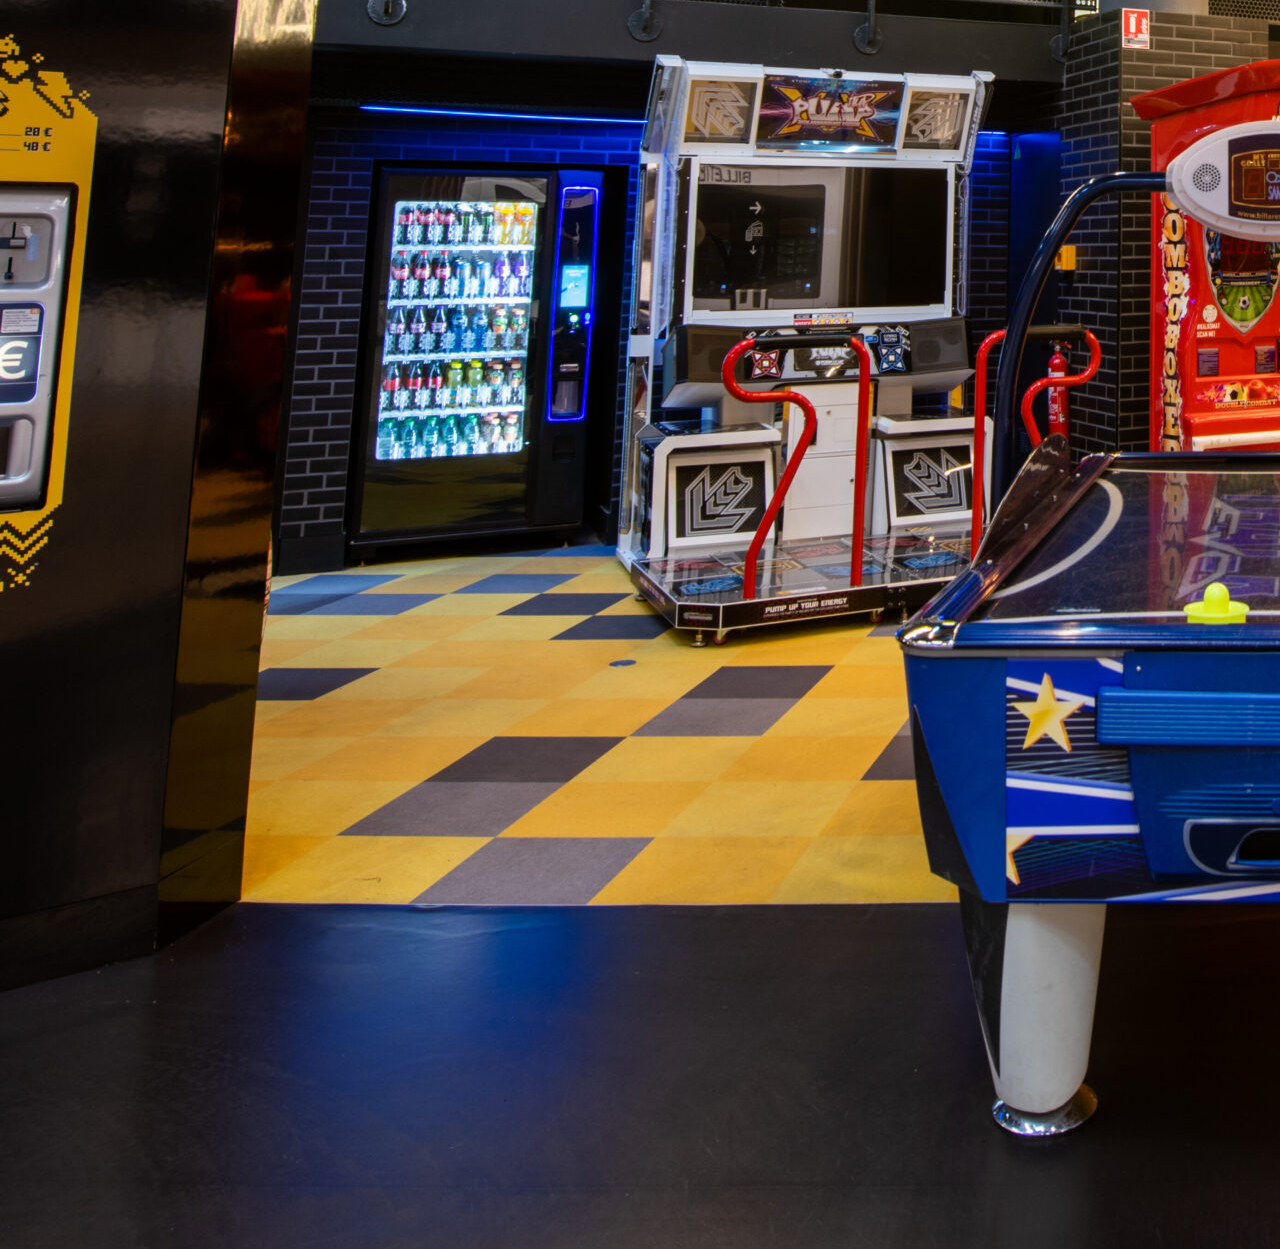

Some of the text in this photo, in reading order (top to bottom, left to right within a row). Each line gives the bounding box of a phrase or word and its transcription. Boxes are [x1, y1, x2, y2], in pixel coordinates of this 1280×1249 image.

[44, 127, 53, 137] €
[42, 142, 51, 152] €
[765, 604, 787, 614] PUMP
[789, 603, 799, 611] UP
[801, 601, 819, 610] YOUR
[821, 598, 848, 608] ENERGY
